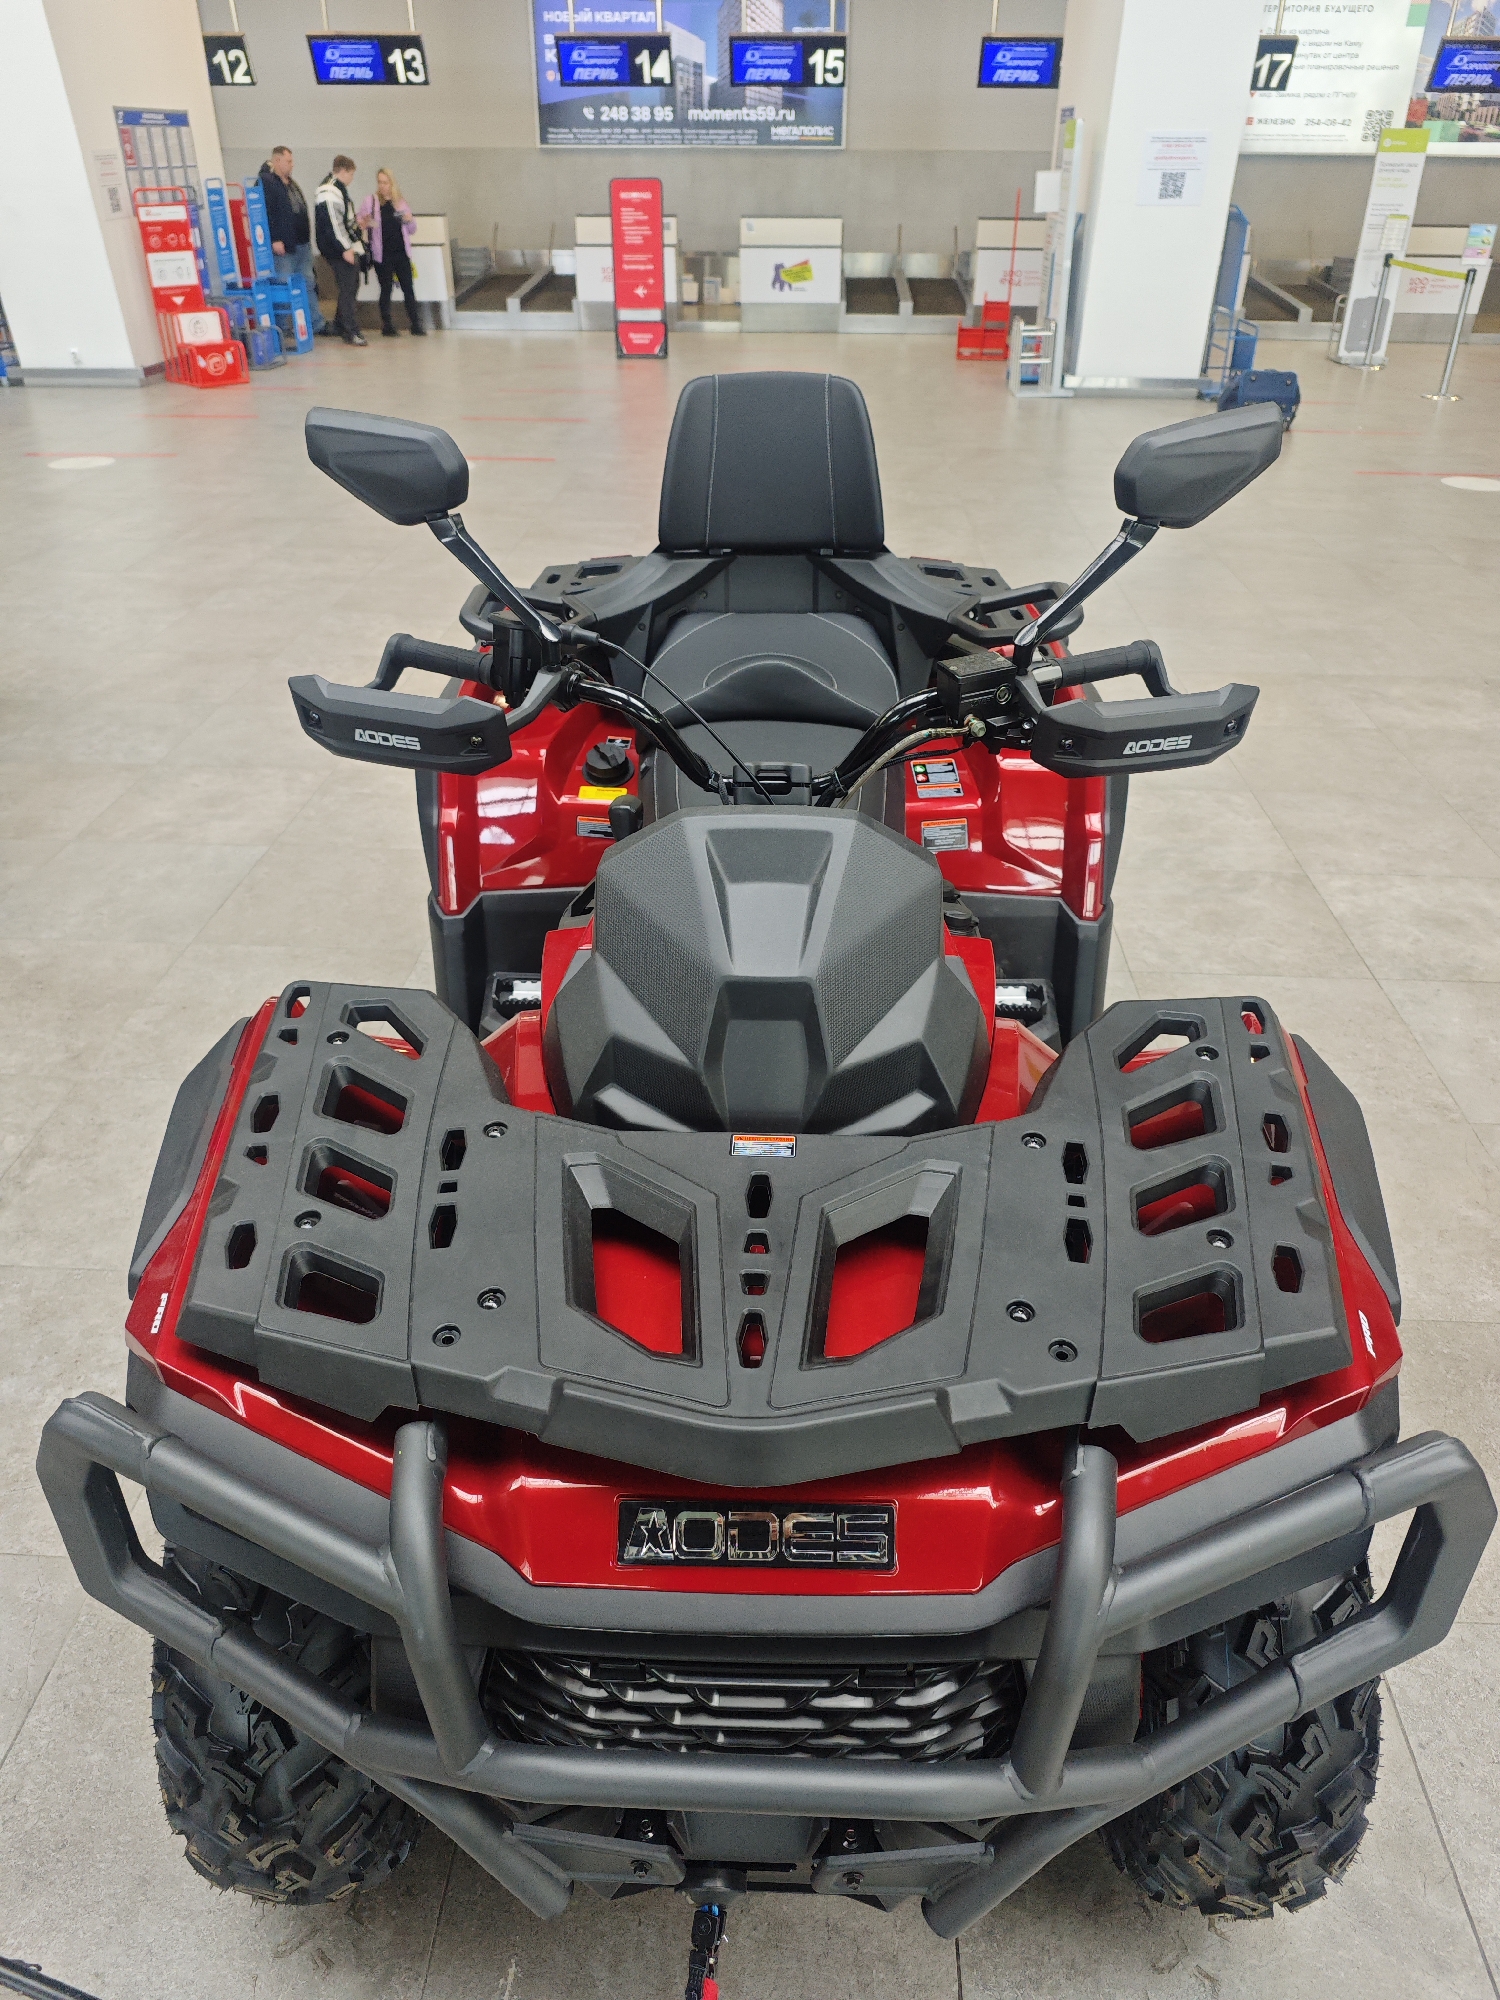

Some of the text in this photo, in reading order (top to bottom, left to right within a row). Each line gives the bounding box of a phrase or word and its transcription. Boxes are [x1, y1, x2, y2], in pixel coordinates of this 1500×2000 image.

[594, 11, 656, 23] КВАРТАЛ
[1263, 4, 1375, 14] ТЕРИТОРИЯ БУДУЩЕГО
[212, 48, 252, 84] 12
[328, 66, 374, 79] ПЕРМЬ
[388, 48, 426, 84] 13
[572, 67, 619, 80] ПЕРМЬ
[634, 49, 672, 84] 14
[744, 67, 792, 80] ПЕРМЬ
[808, 48, 845, 85] 15
[1254, 53, 1293, 88] 17
[992, 69, 1040, 82] ПЕРМЬ
[1443, 73, 1494, 86] ПЕРМЬ
[600, 105, 674, 122] 248 38 95
[687, 105, 796, 122] moments59.ru
[354, 728, 421, 751] AODES
[1122, 734, 1193, 755] AODES
[623, 1506, 889, 1563] AODES
